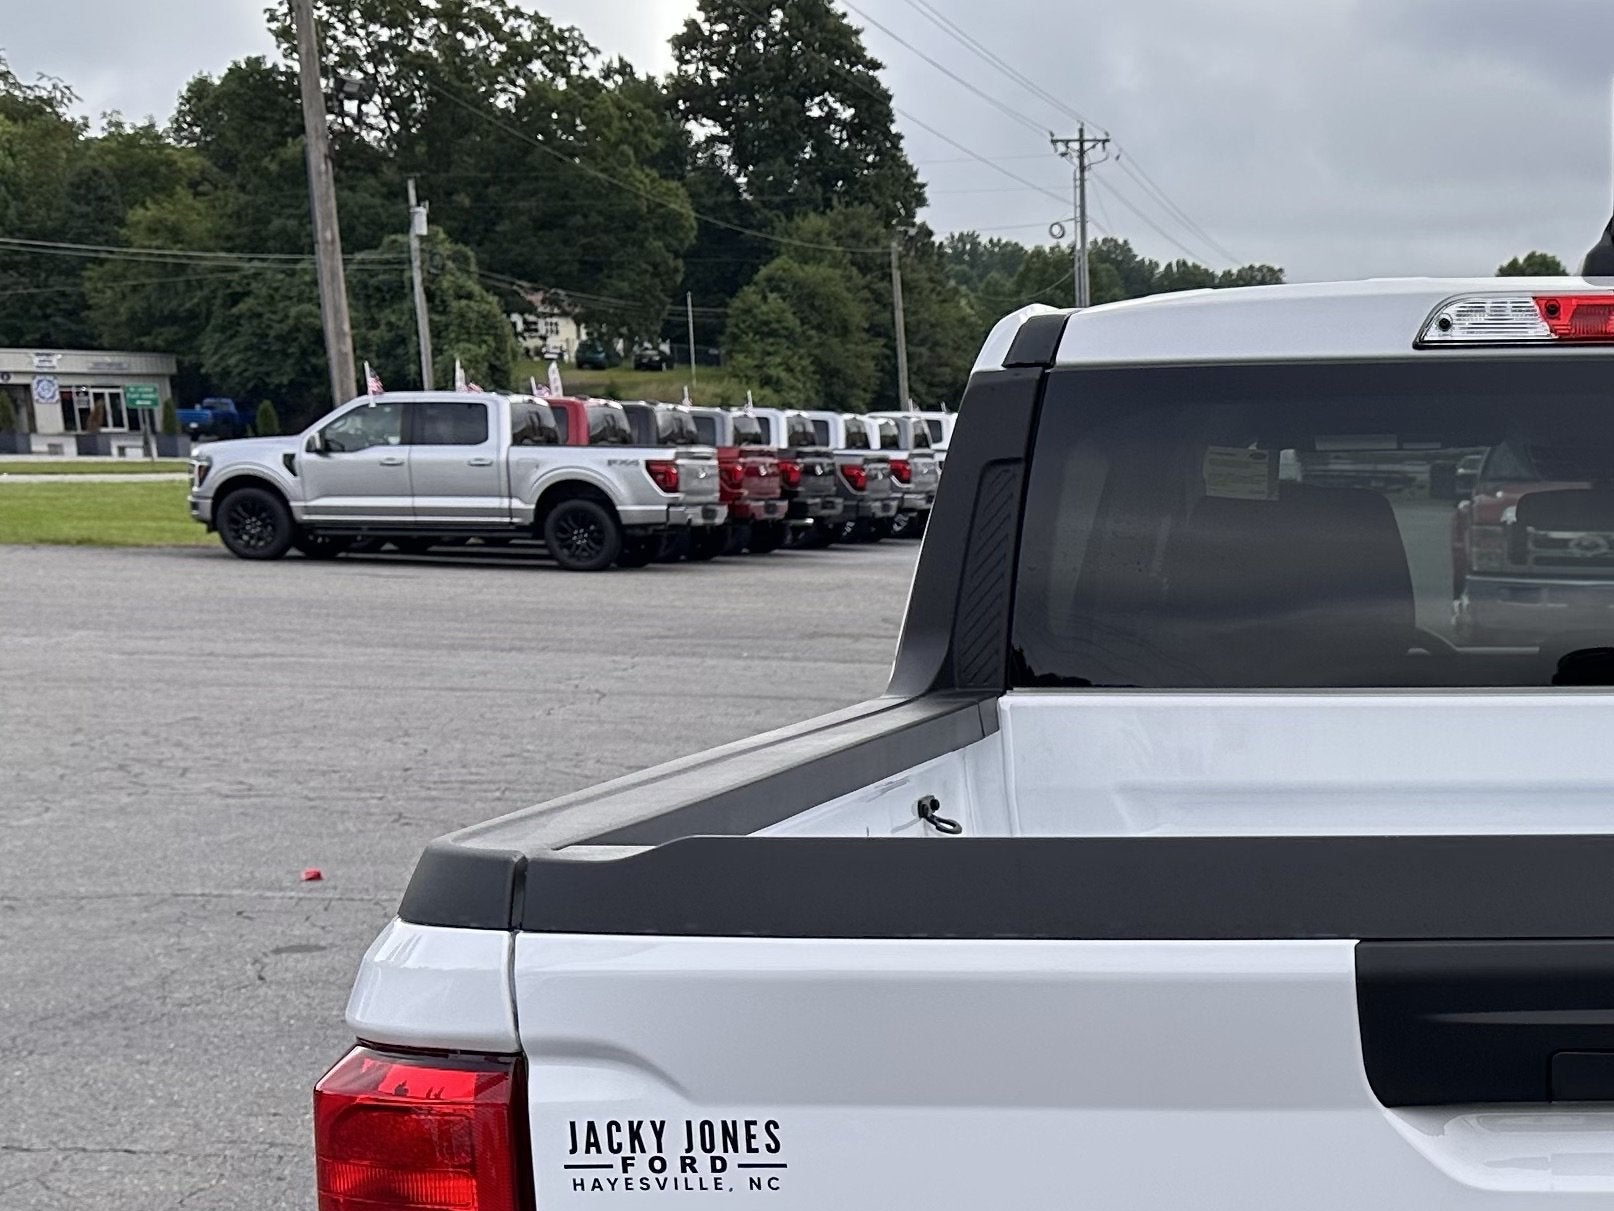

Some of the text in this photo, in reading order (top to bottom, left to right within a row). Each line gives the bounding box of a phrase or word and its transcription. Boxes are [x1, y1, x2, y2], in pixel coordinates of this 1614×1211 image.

[568, 1119, 782, 1155] JACKY JONES
[620, 1155, 728, 1175] FORD
[572, 1176, 780, 1193] HAYESVILLE, NC
